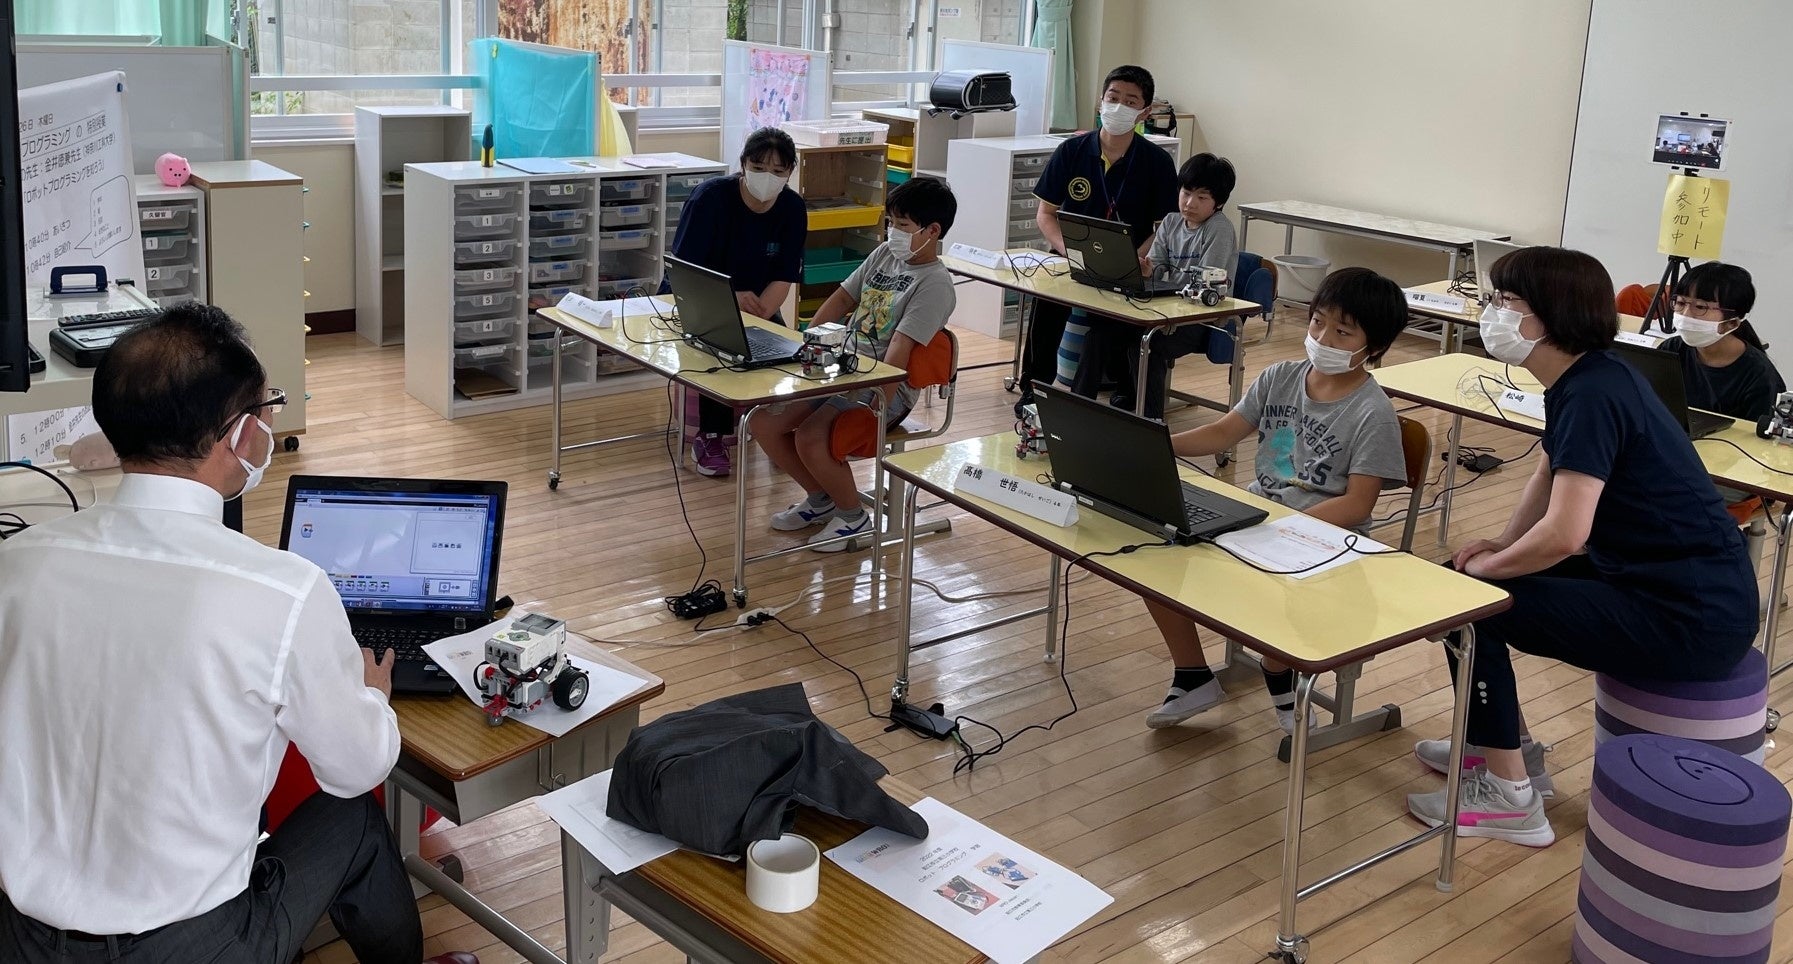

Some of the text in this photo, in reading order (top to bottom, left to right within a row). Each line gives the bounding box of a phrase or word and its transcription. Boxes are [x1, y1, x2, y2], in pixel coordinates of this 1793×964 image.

[1671, 190, 1692, 245] 参加中
[1694, 186, 1710, 250] リモート
[151, 269, 157, 279] 2
[1265, 404, 1298, 420] INNER
[1322, 434, 1343, 457] ALL
